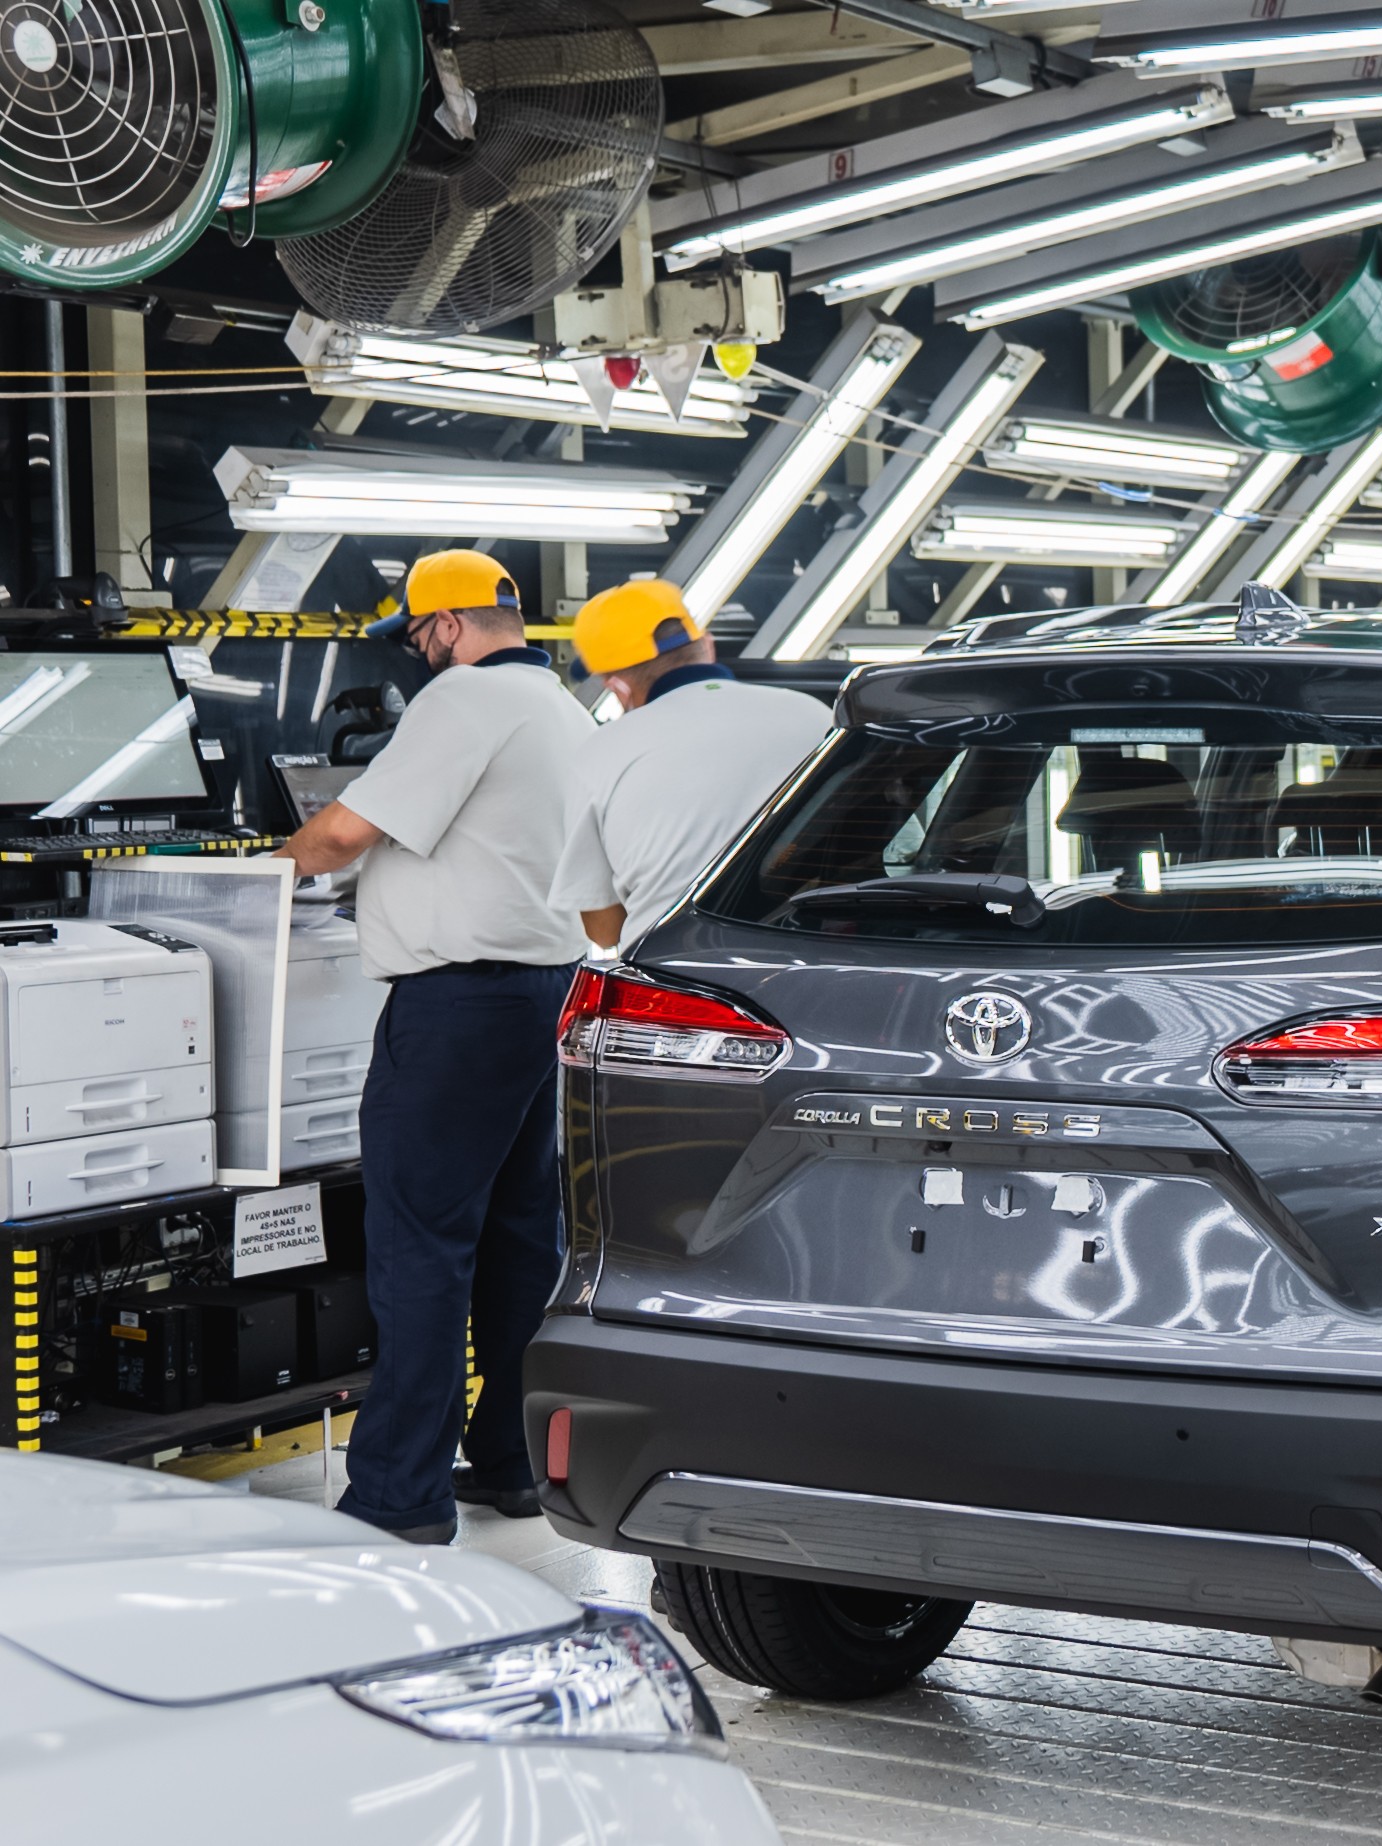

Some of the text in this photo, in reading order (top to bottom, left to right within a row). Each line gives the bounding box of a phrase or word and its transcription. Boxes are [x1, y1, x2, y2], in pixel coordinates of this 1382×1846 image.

[835, 152, 847, 181] 9
[794, 1104, 1101, 1138] COROLLA CROSS
[245, 1202, 311, 1222] FAVOR MANTER O
[280, 1216, 296, 1226] NAS
[241, 1224, 317, 1245] IMPRESSORAS E NO
[236, 1246, 262, 1258] LOCAL
[264, 1242, 275, 1252] DE
